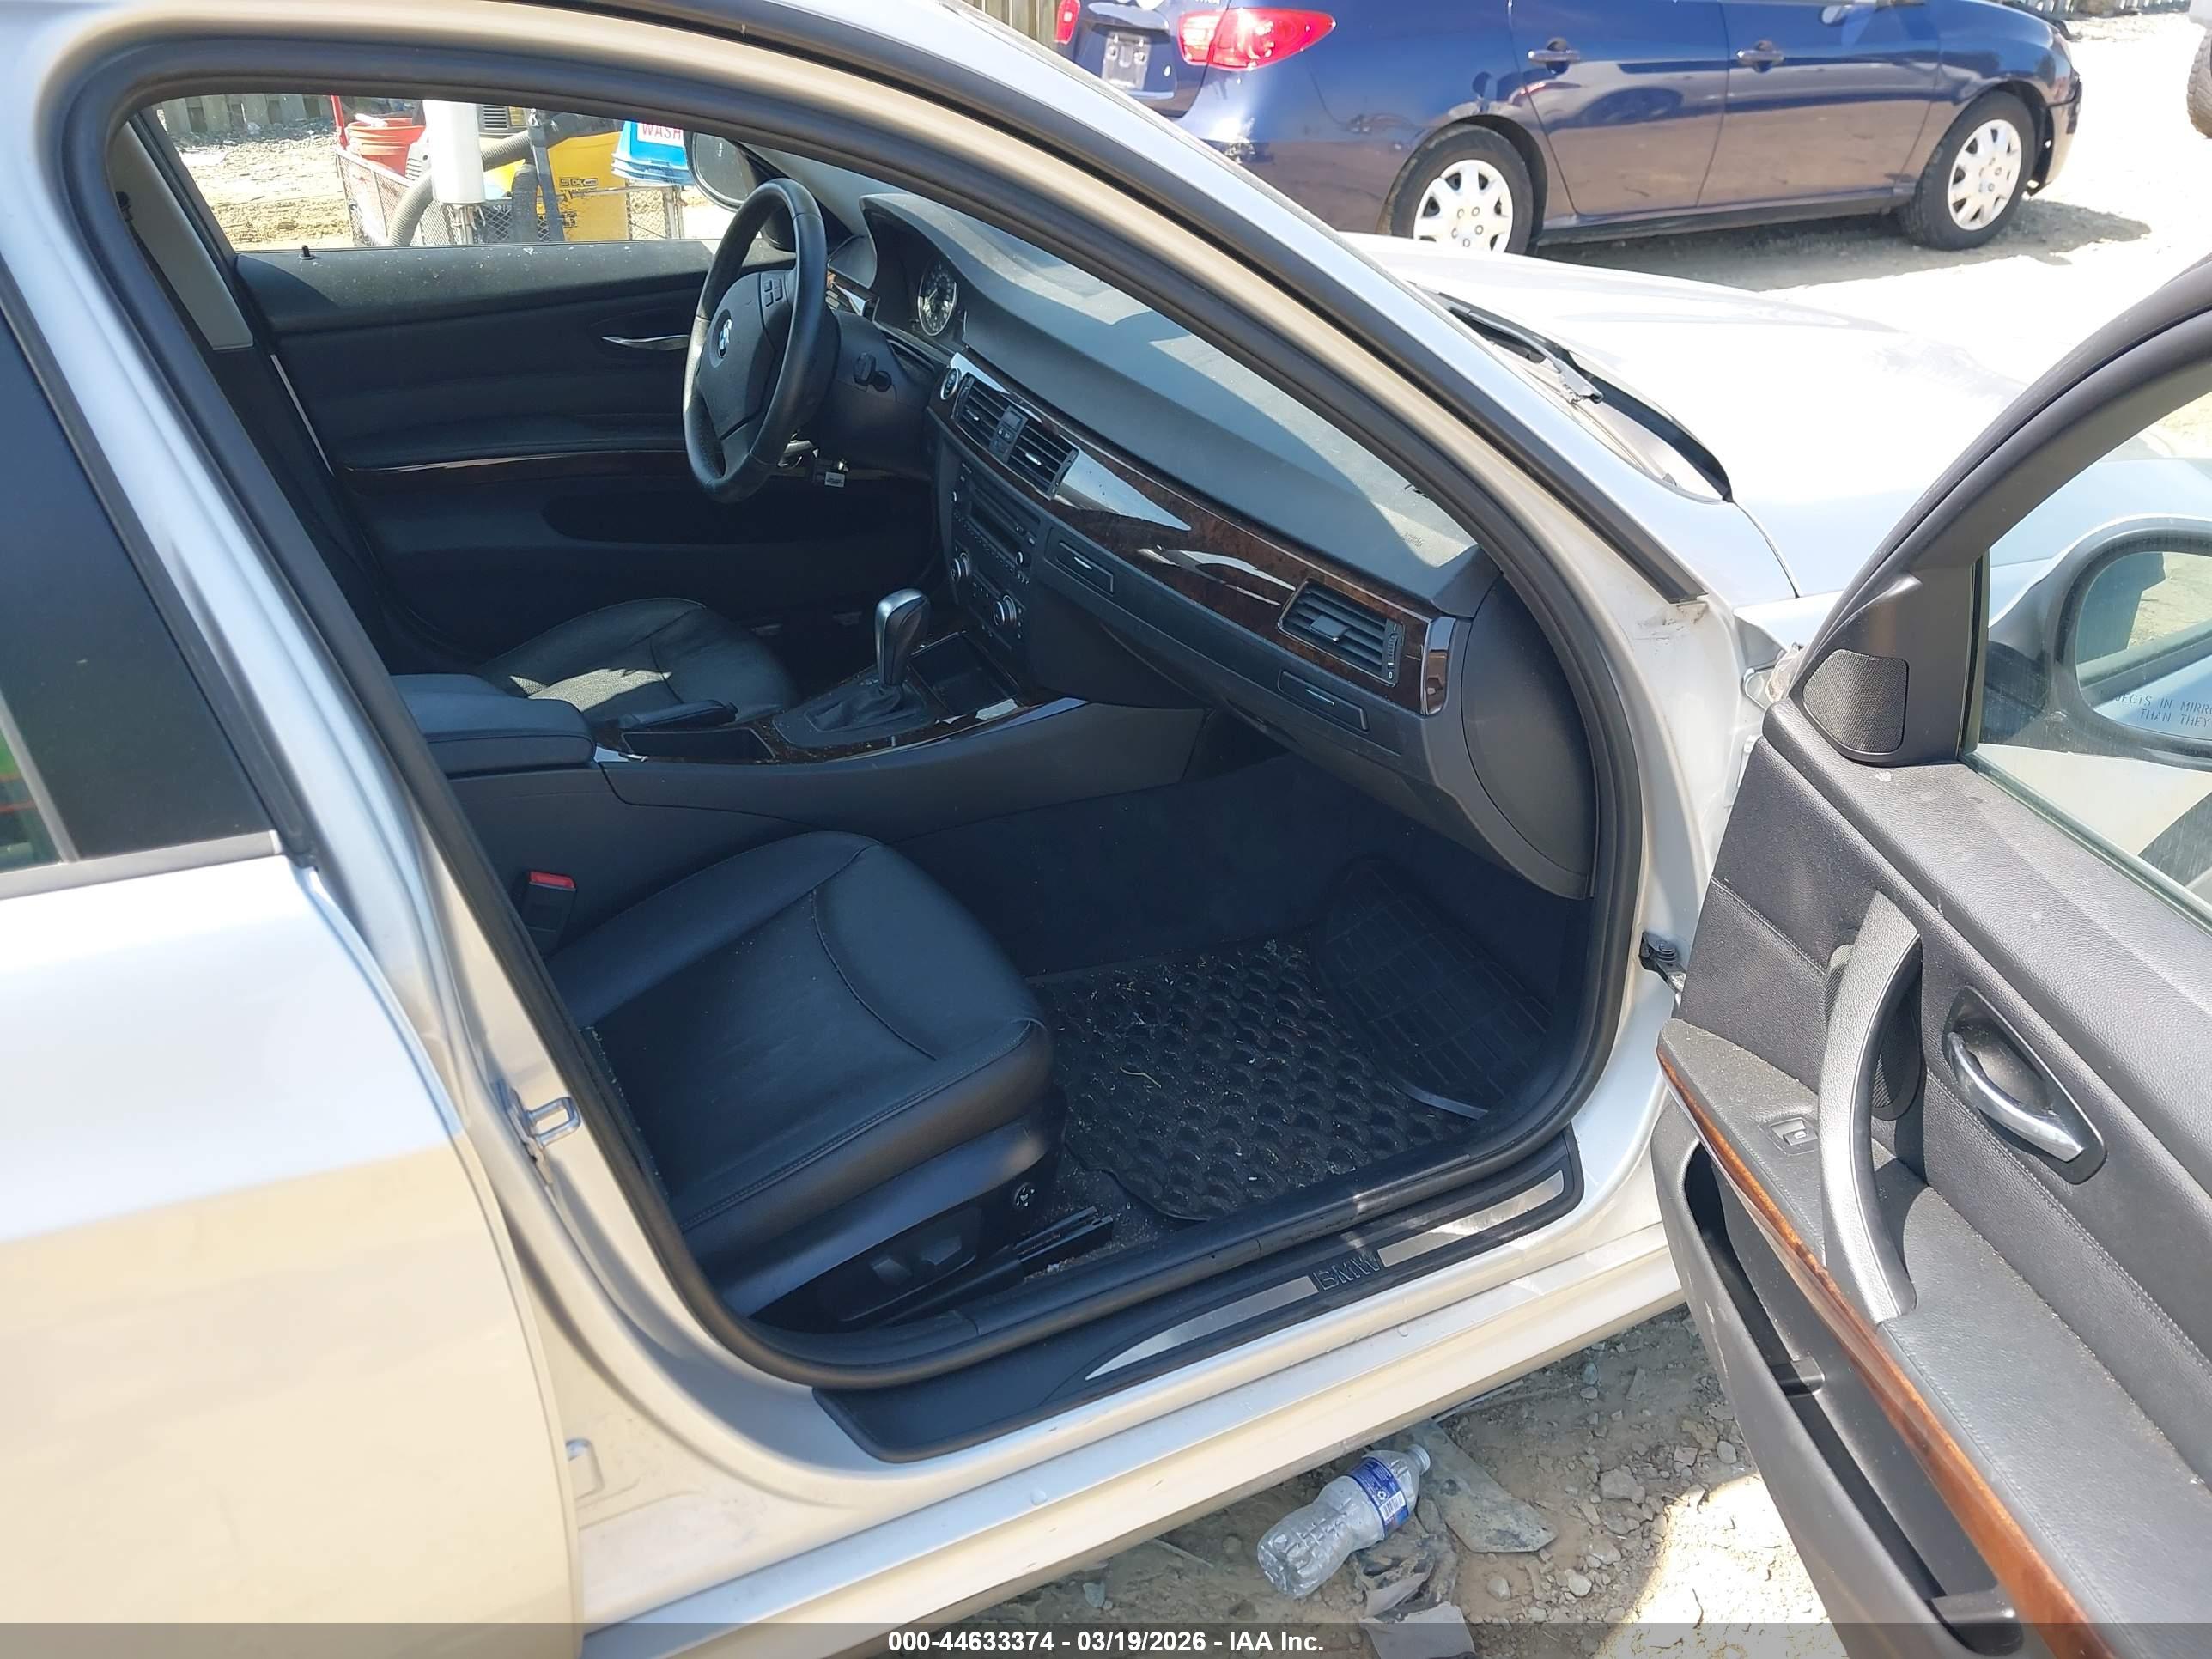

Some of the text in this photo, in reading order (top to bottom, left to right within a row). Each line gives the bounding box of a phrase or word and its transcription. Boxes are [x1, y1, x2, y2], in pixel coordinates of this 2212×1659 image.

[641, 123, 682, 140] WASH
[2114, 693, 2153, 707] JECTS
[2160, 697, 2174, 709] IN
[2140, 708, 2212, 728] THAN THEY
[1312, 1250, 1381, 1291] BMW
